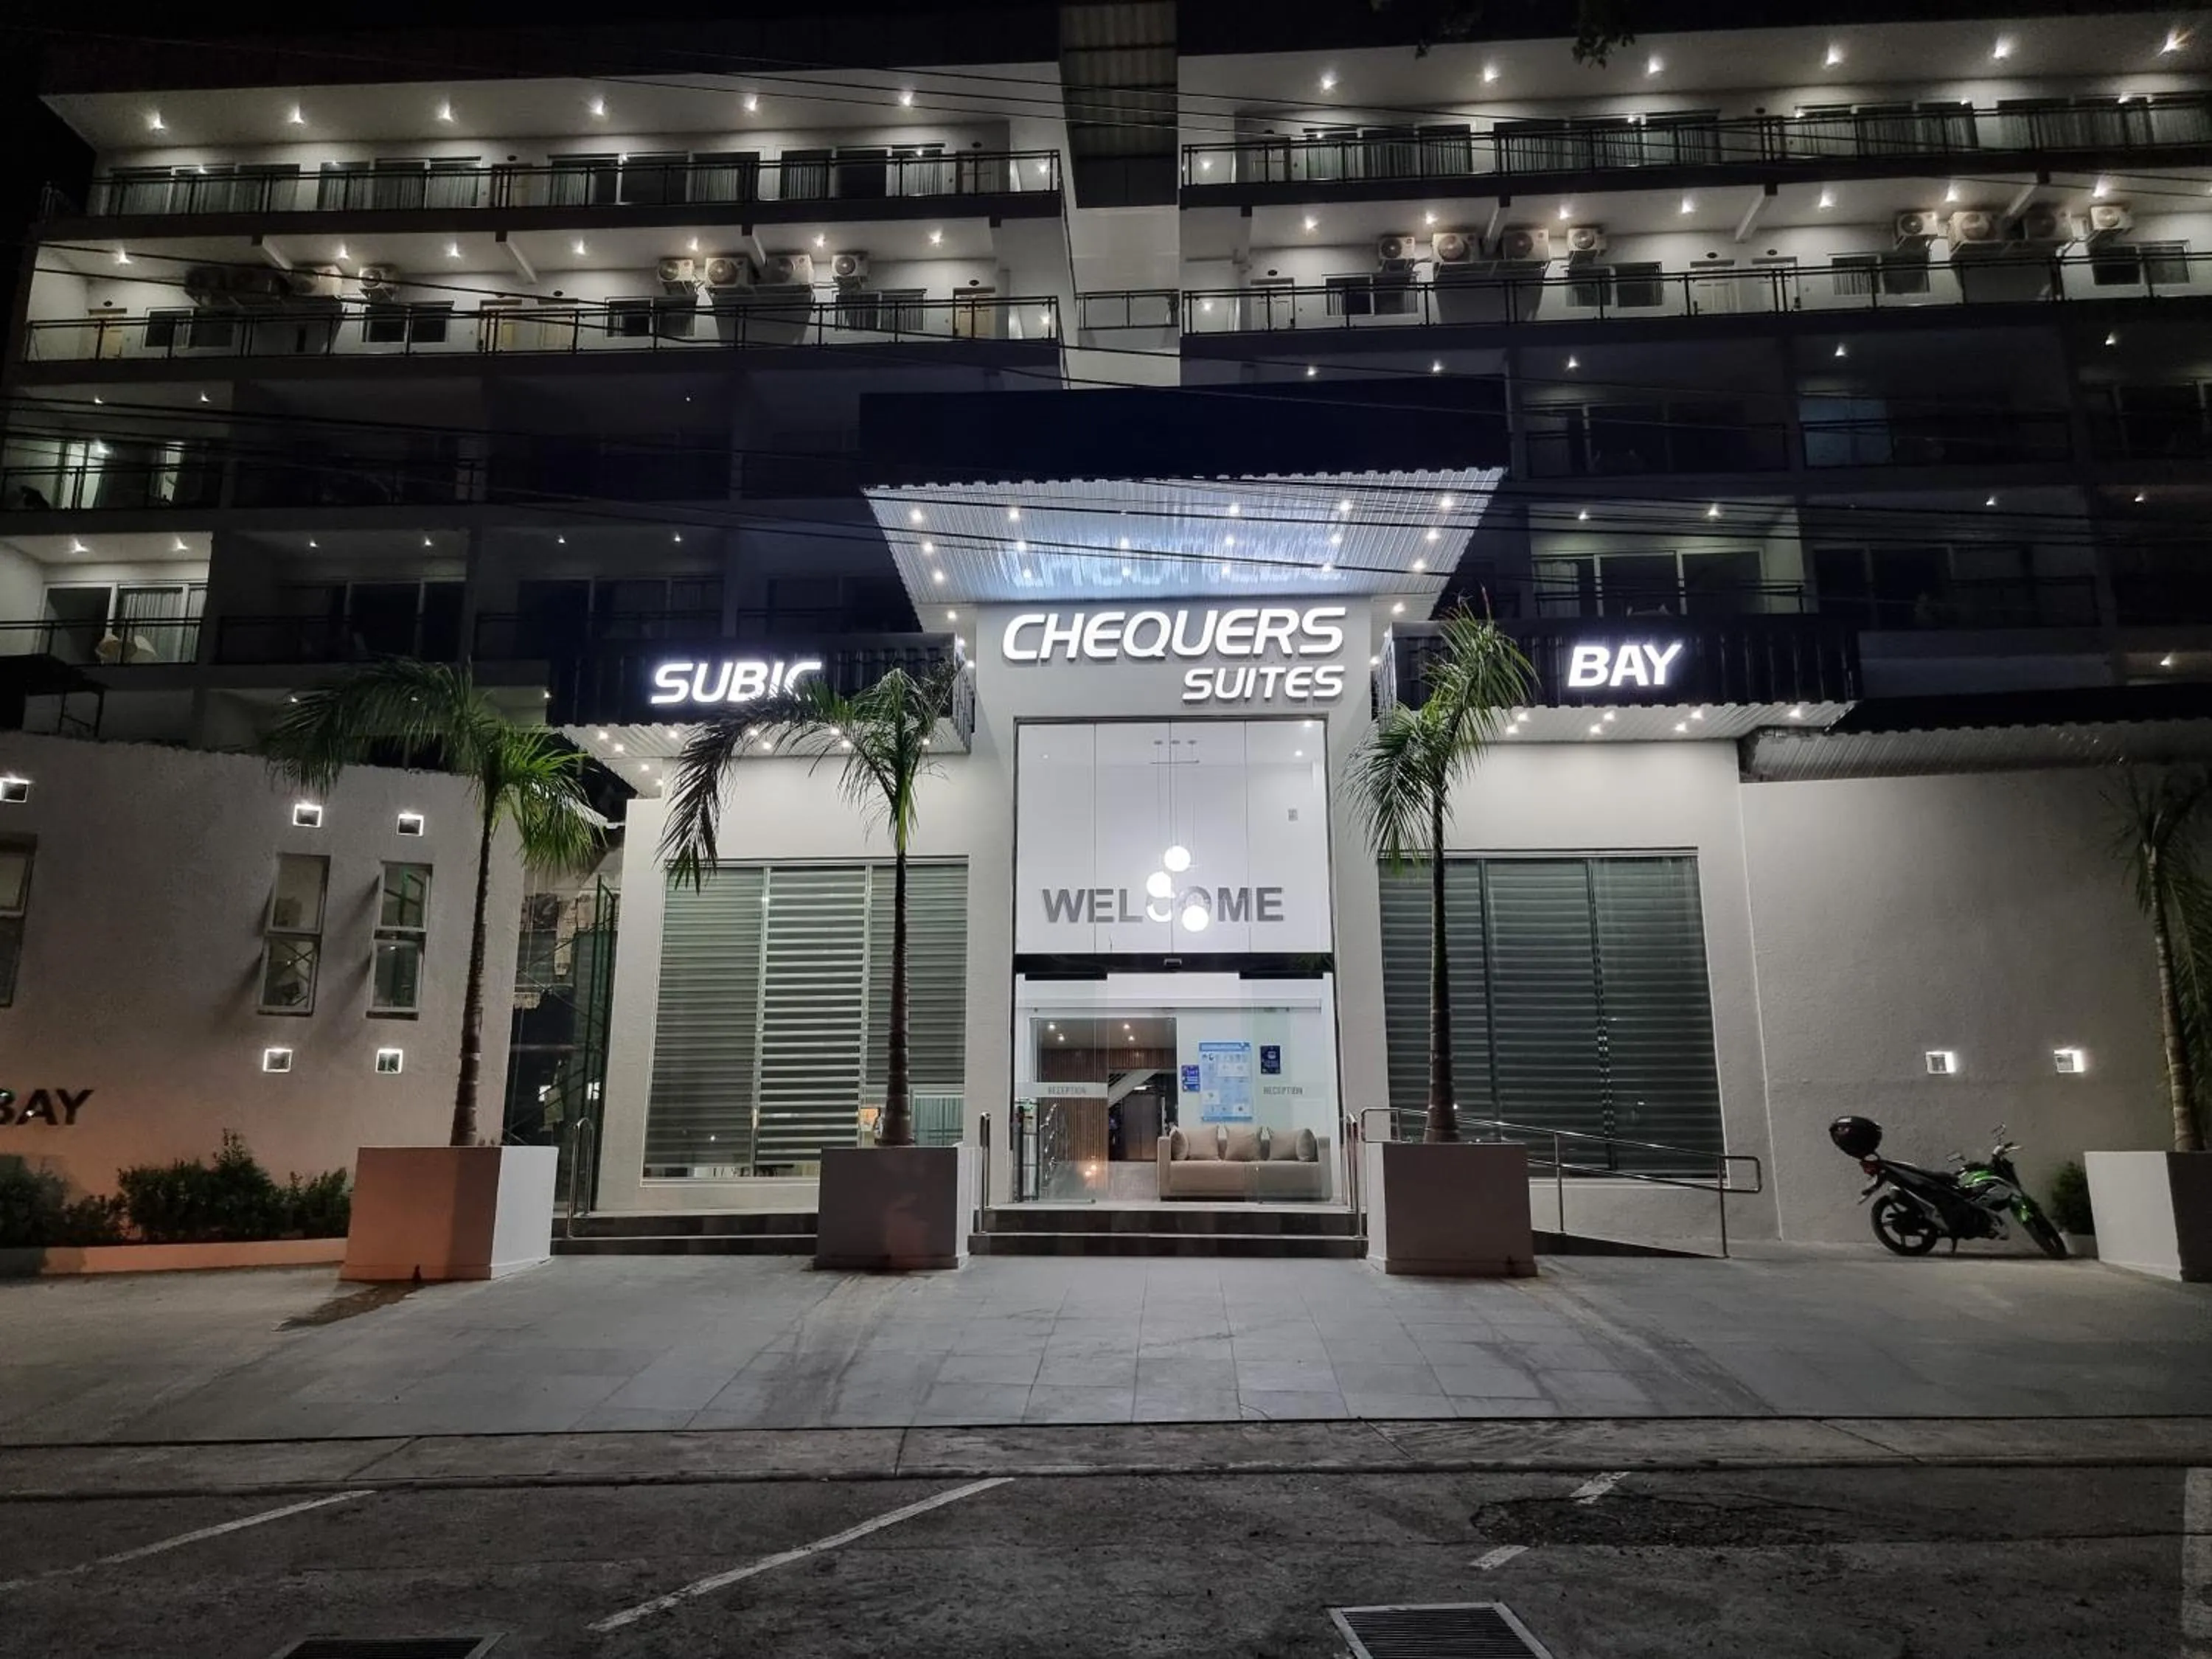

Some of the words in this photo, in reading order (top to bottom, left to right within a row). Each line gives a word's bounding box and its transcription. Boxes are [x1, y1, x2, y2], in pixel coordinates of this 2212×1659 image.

[1003, 607, 1346, 661] CHEQUERS
[650, 661, 822, 704] SUBIC
[1182, 665, 1345, 701] SUITES
[1568, 644, 1683, 687] BAY
